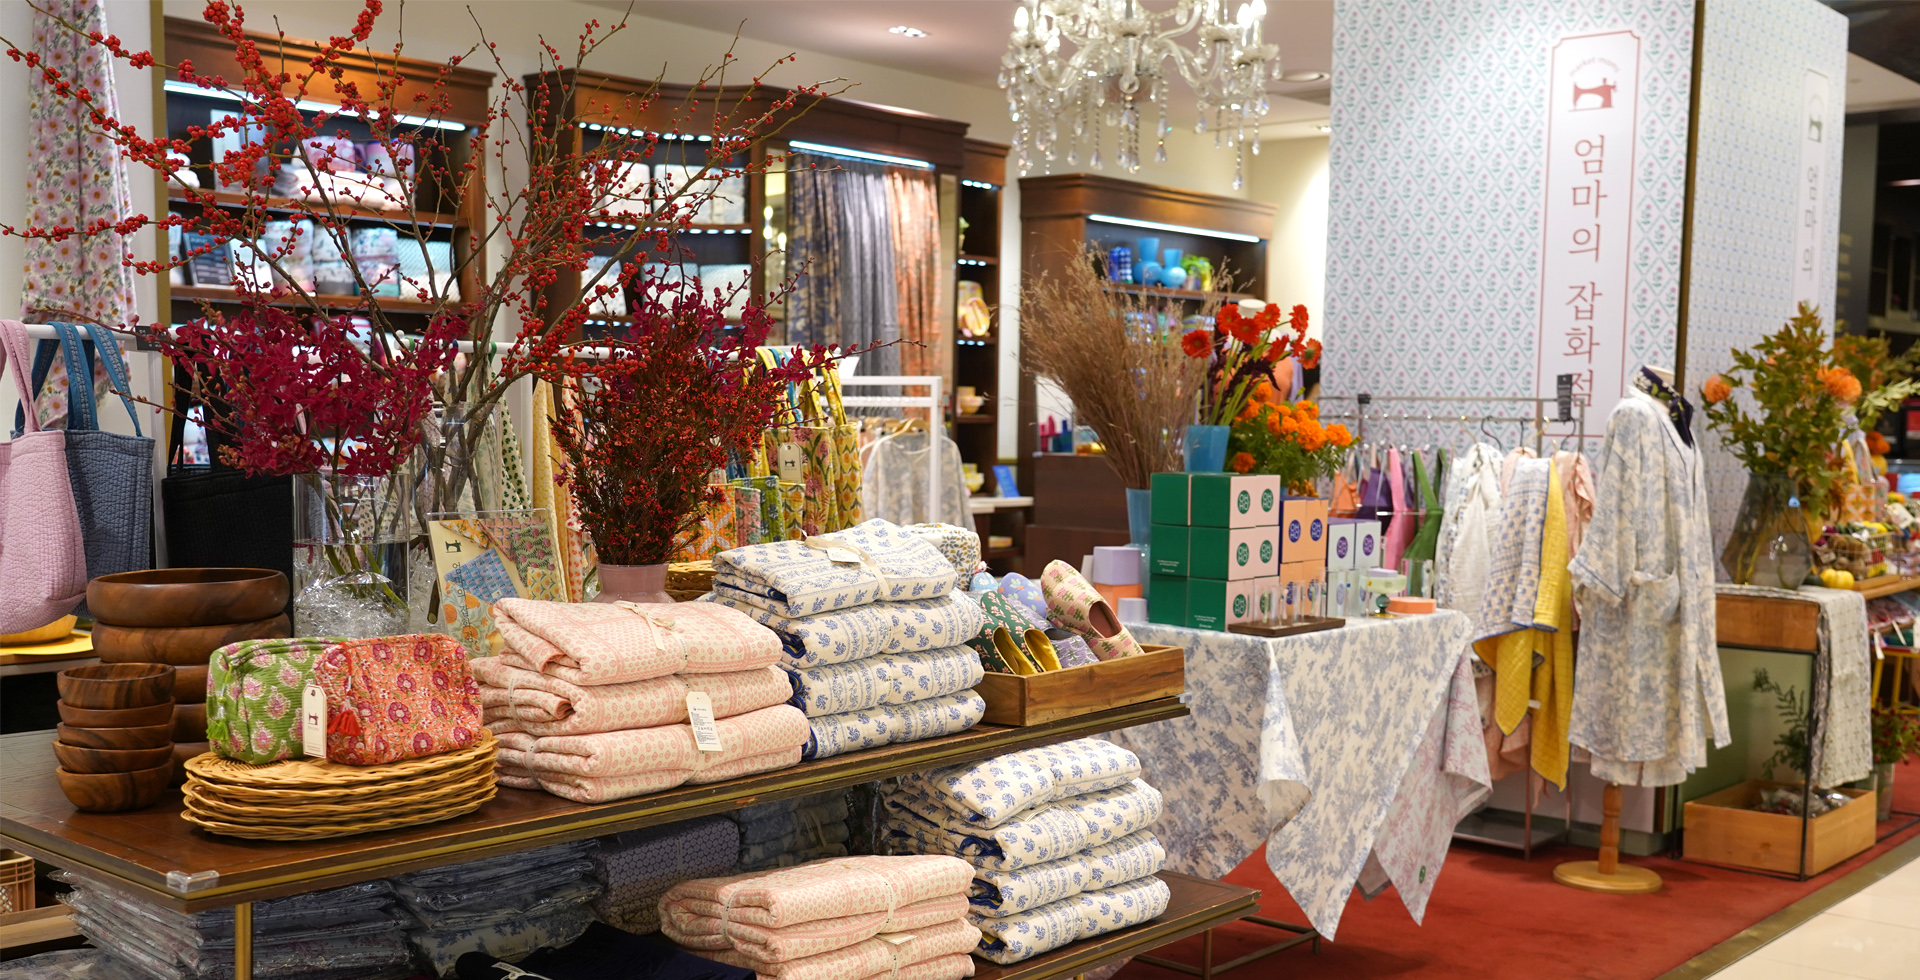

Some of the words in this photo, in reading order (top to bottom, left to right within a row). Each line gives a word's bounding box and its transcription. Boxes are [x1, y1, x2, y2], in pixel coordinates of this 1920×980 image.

[1568, 134, 1608, 263] 엄마의
[1802, 165, 1819, 281] 엄마의
[1563, 281, 1603, 407] 잡화점
